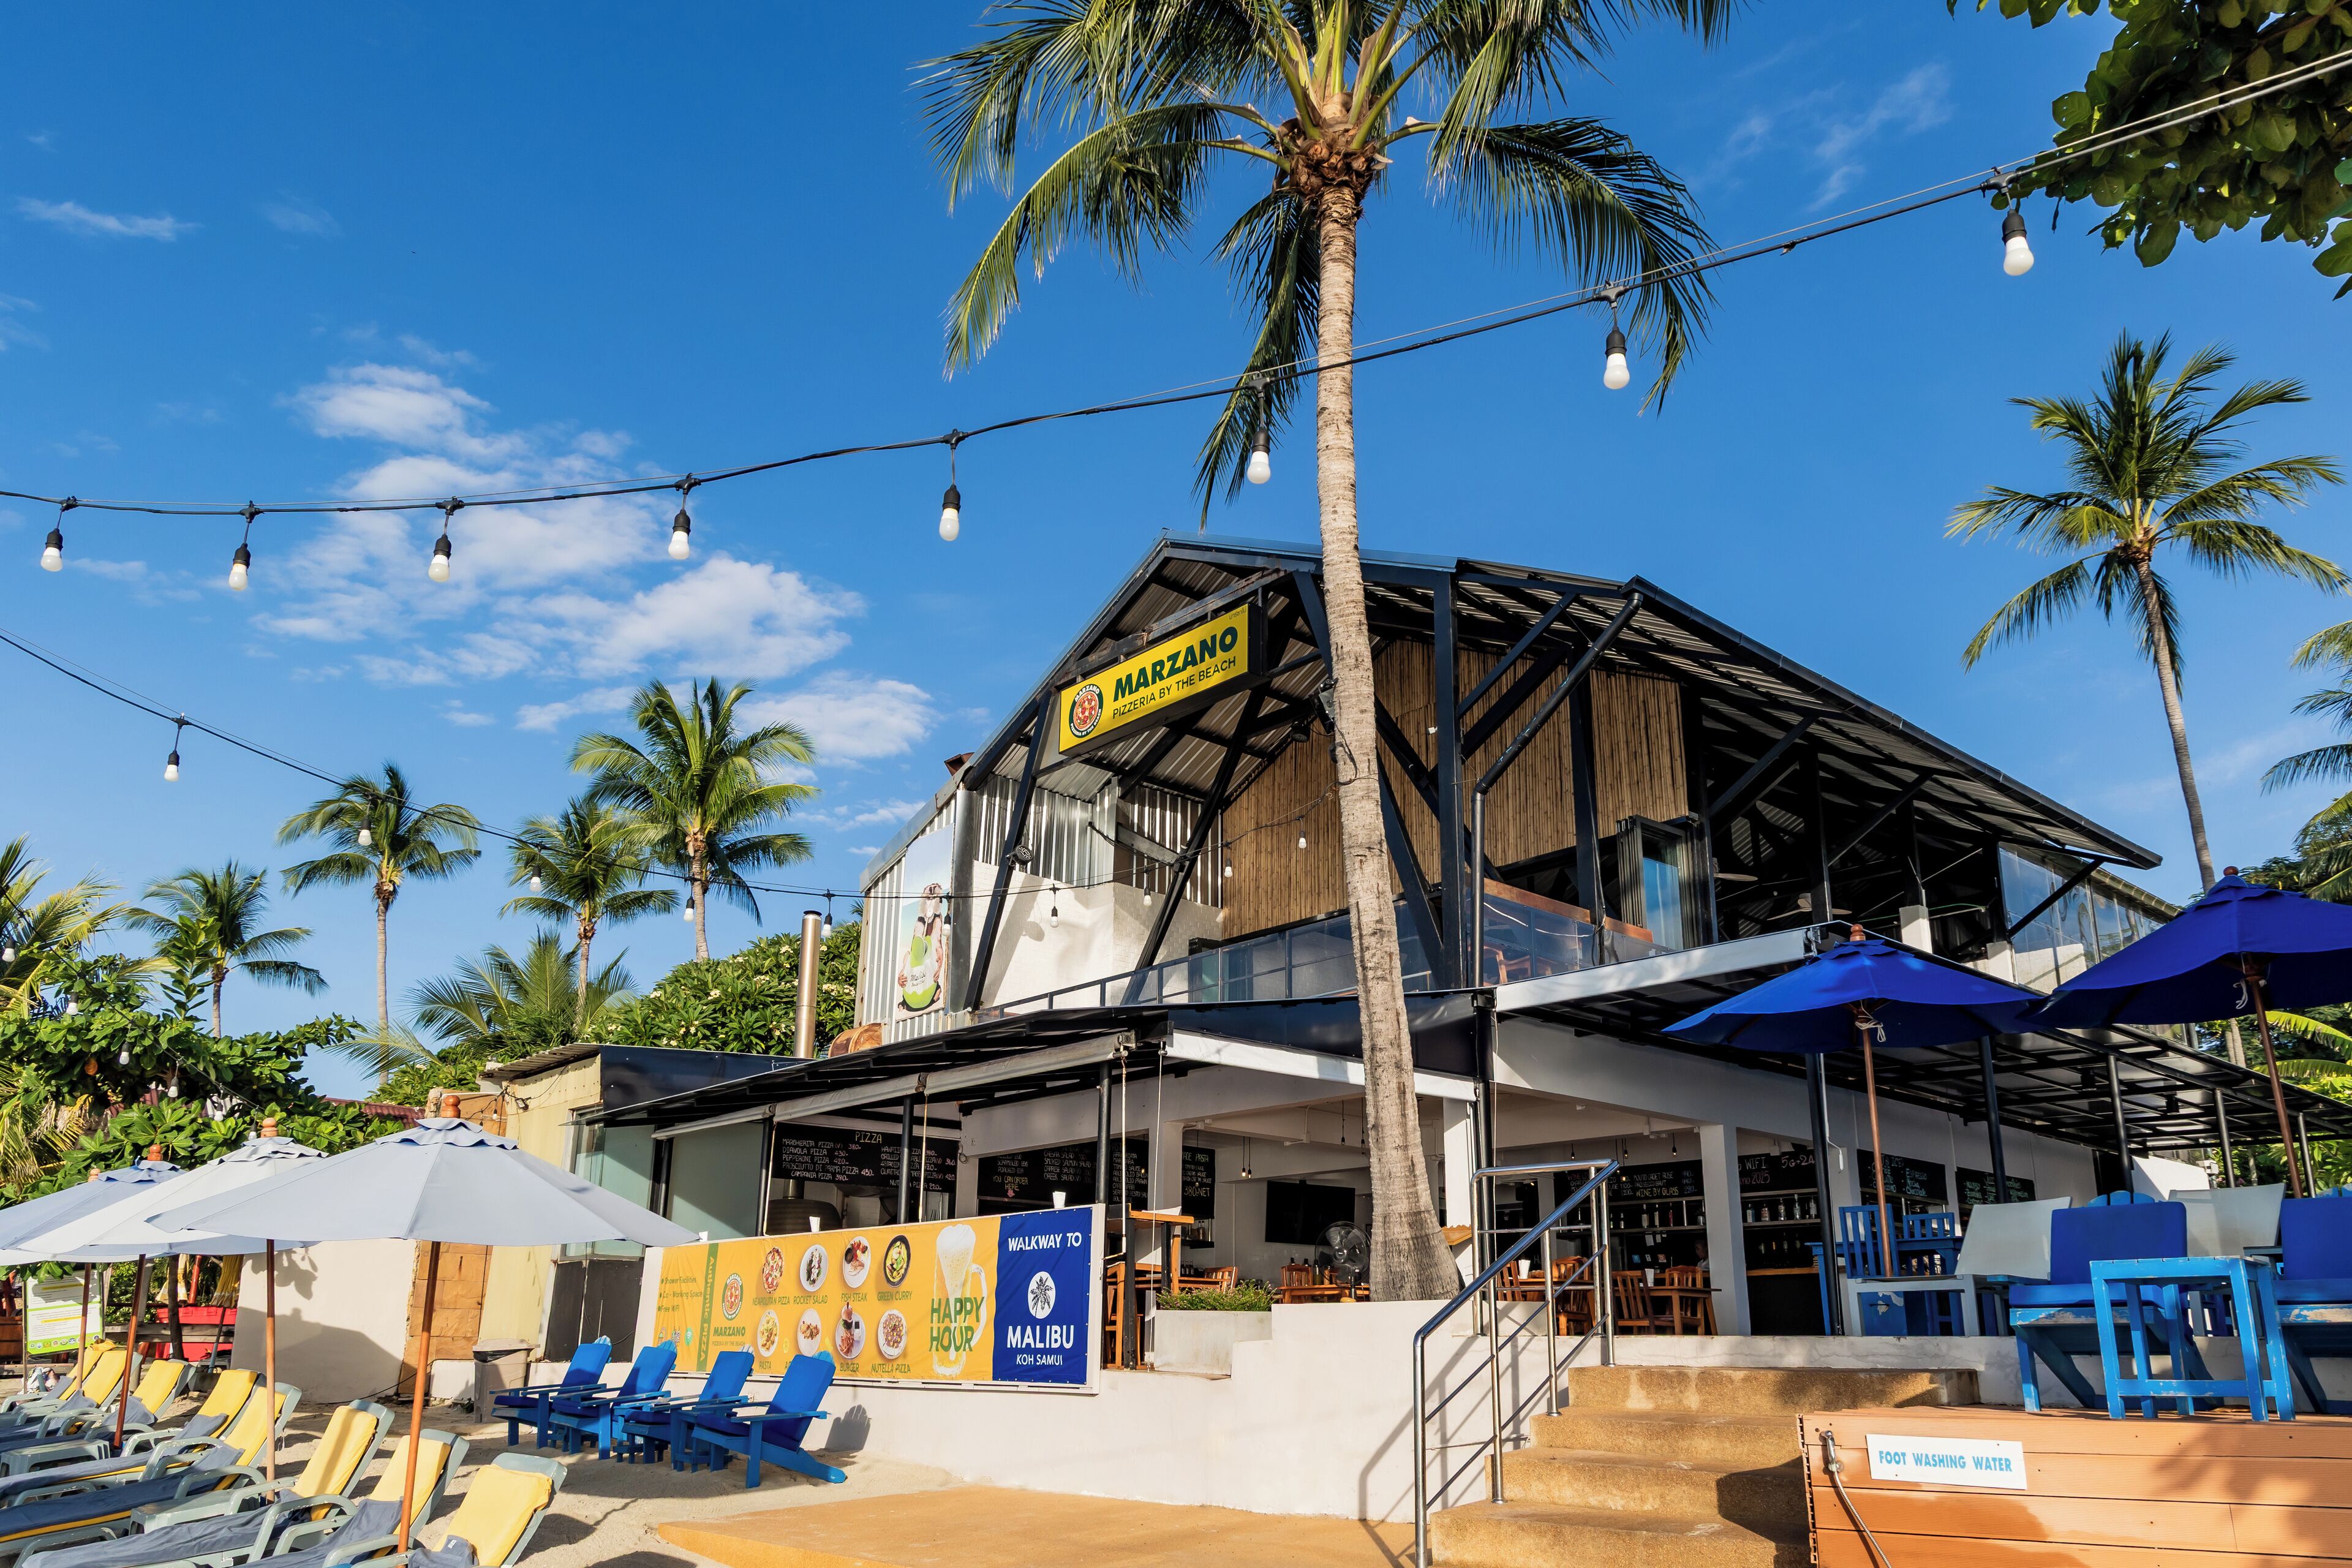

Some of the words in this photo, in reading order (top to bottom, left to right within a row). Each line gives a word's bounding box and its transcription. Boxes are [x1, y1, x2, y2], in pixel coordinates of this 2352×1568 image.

[1113, 626, 1238, 703] MARZANO
[1112, 693, 1156, 719] PIZZERIA
[1159, 685, 1172, 699] BY
[1175, 674, 1195, 692] THE
[1198, 656, 1236, 682] BEACH
[1074, 685, 1100, 702] MARZANO
[782, 1139, 815, 1147] MARGHERITA
[855, 1132, 882, 1144] PIZZA
[1196, 1153, 1208, 1163] PASTA
[1744, 1156, 1767, 1169] WIFI
[782, 1162, 813, 1170] PROSCIUTTO
[842, 1166, 859, 1175] PIZZA
[1014, 1177, 1028, 1185] ORDER
[1637, 1188, 1652, 1197] WINE
[1662, 1186, 1678, 1196] GLASS
[1008, 1233, 1063, 1251] WALKWAY
[1066, 1232, 1082, 1248] TO
[704, 1256, 715, 1319] Authentic
[673, 1291, 689, 1300] Working
[752, 1297, 777, 1305] NEAPOLITAN
[778, 1296, 790, 1305] PIZZA
[793, 1295, 812, 1304] ROCKET
[812, 1295, 828, 1304] SALAD
[841, 1293, 851, 1302] FISH
[852, 1292, 867, 1302] STEAK
[877, 1292, 893, 1301] GREEN
[895, 1291, 913, 1300] CURRY
[930, 1296, 985, 1324] HAPPY
[713, 1326, 745, 1336] MARZANO
[699, 1323, 708, 1361] PIZZA
[929, 1325, 974, 1352] HOUR
[1007, 1325, 1074, 1349] MALIBU
[1016, 1354, 1034, 1365] KOH
[1036, 1354, 1063, 1365] SAMUI
[759, 1361, 771, 1370] PASTA
[840, 1362, 859, 1373] BURGER
[871, 1363, 894, 1373] NUTELLA
[895, 1364, 911, 1373] PIZZA
[1879, 1450, 1907, 1466] FOOT
[1912, 1452, 1966, 1469] WASHING
[1972, 1456, 2013, 1472] WATER
